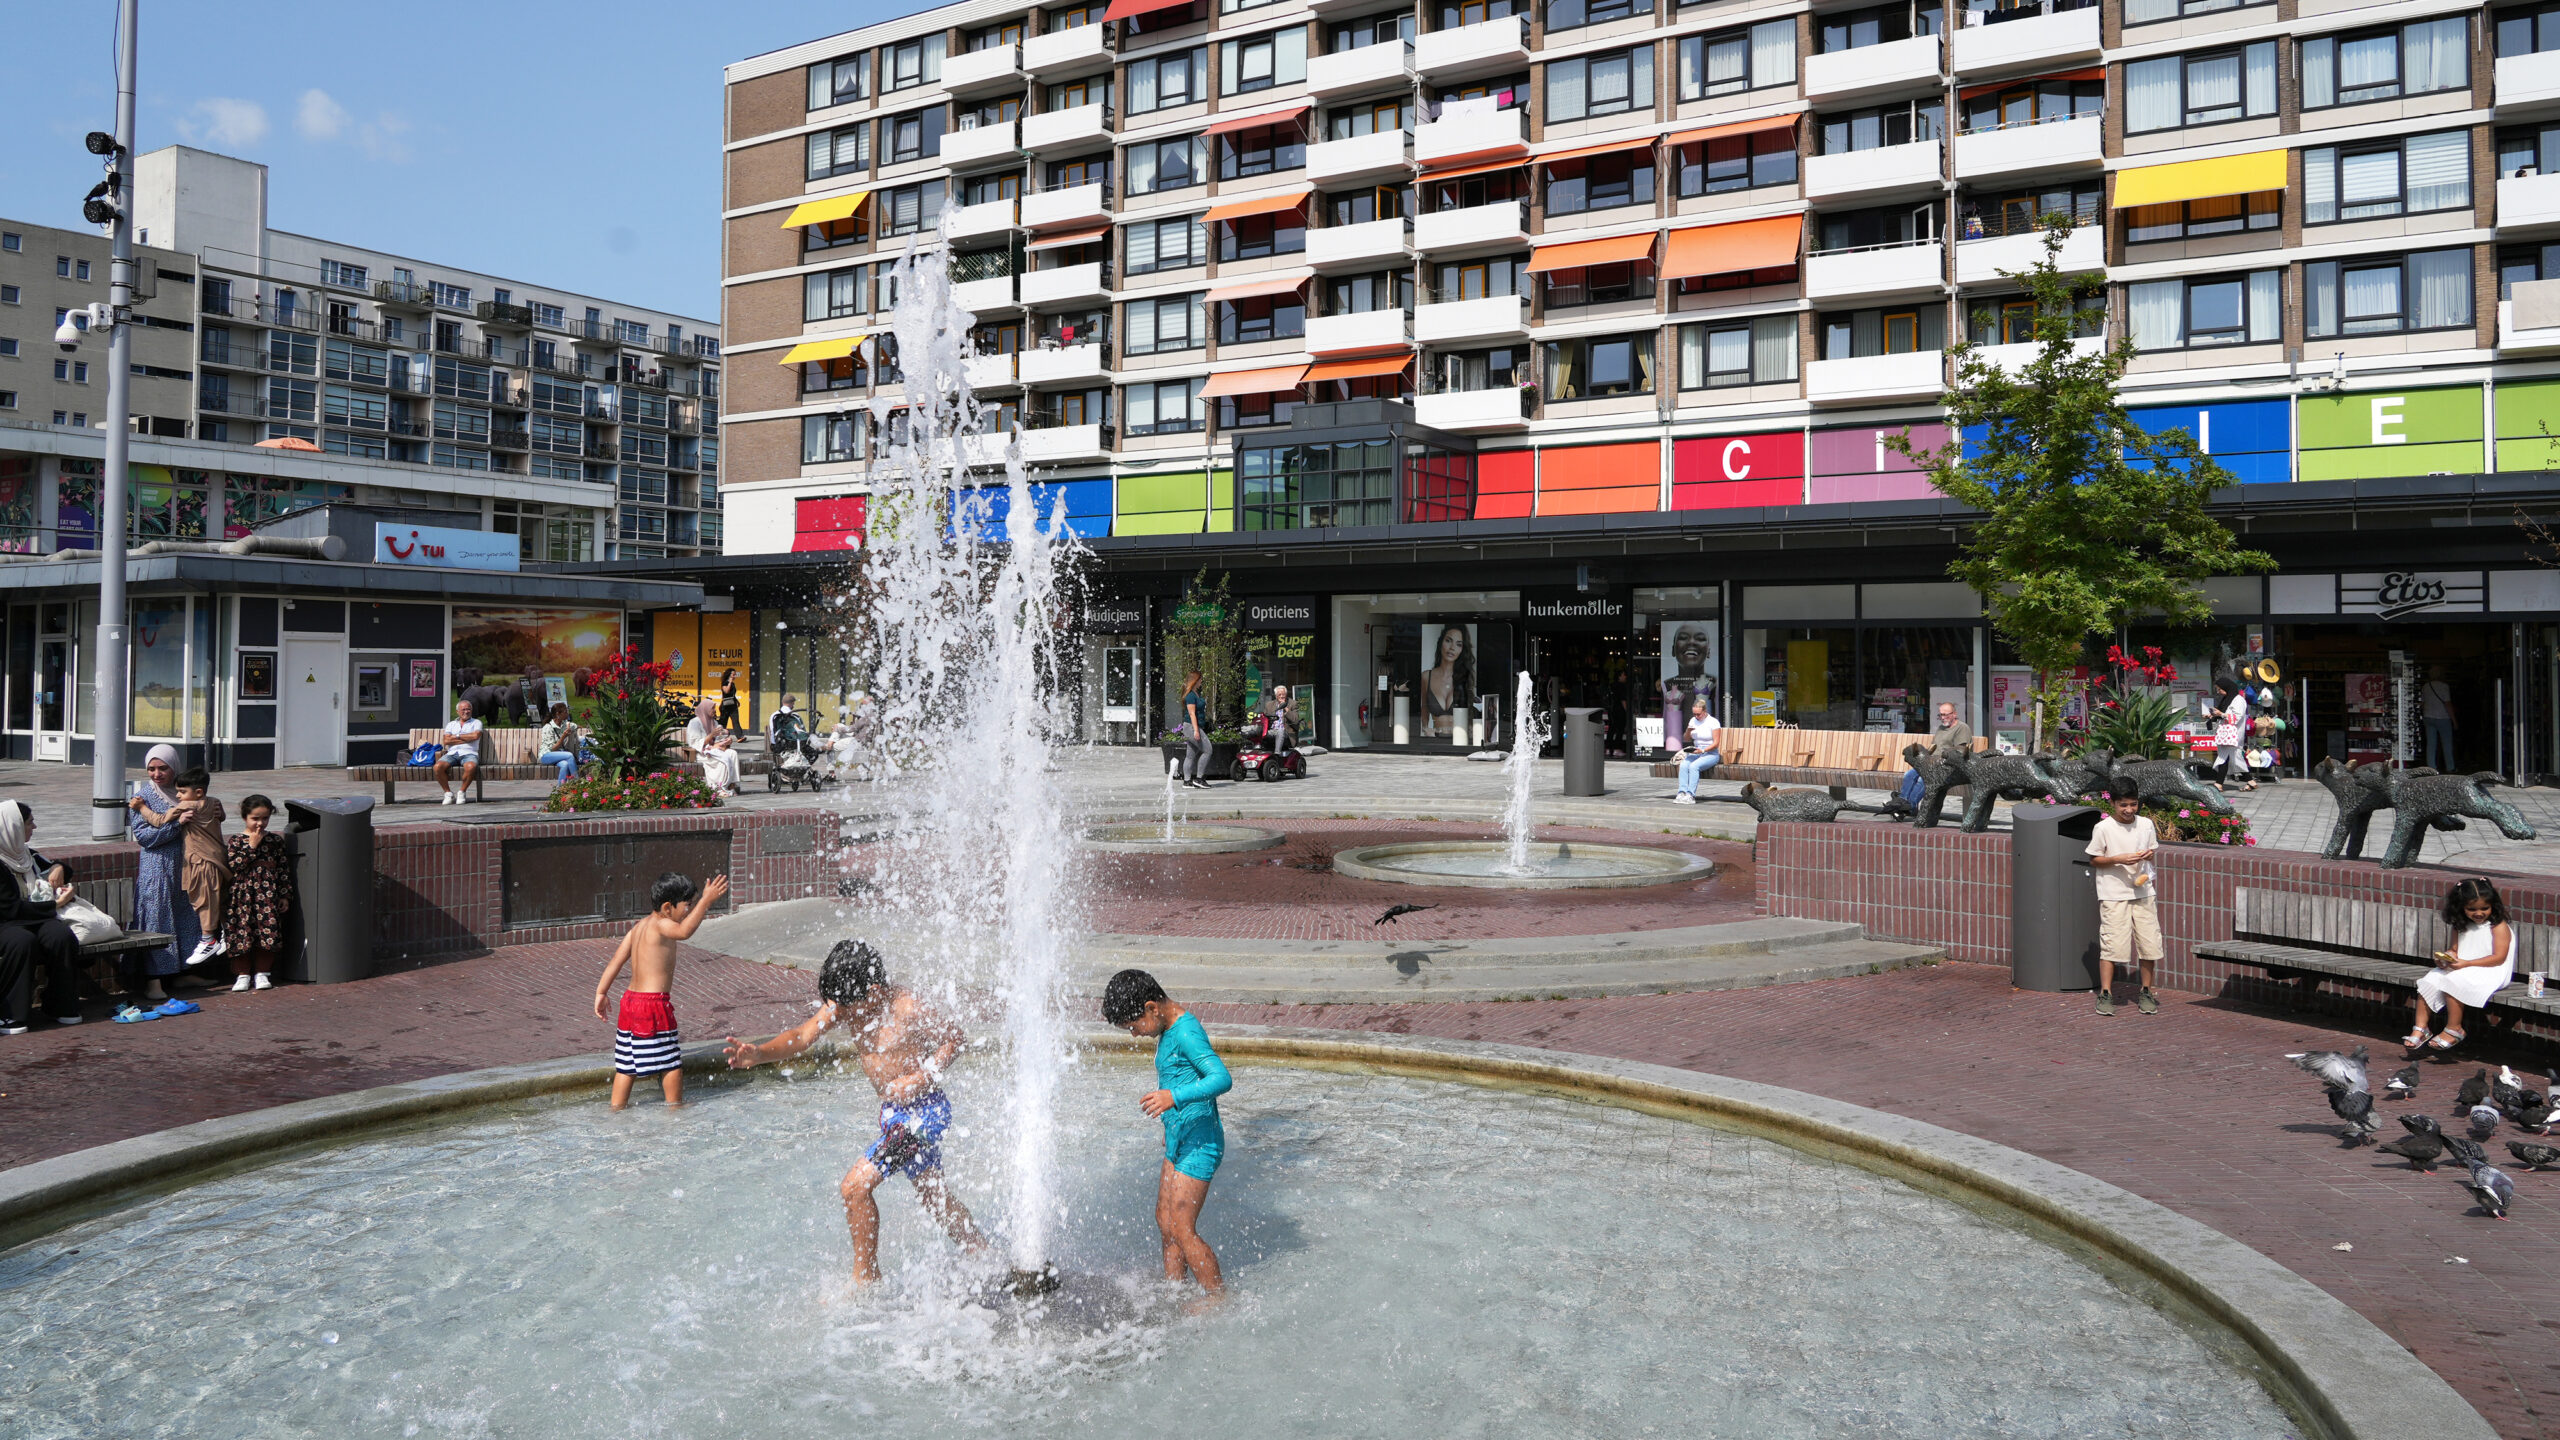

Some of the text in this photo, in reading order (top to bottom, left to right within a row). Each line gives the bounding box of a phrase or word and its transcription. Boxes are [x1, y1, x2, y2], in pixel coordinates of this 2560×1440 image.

[421, 544, 445, 558] TUI
[2377, 572, 2447, 607] Etos
[1086, 608, 1140, 622] Audiciens
[1251, 605, 1310, 622] Opticiens
[1527, 599, 1623, 617] hunkemöller
[1277, 634, 1314, 648] Super
[708, 648, 743, 659] TE HUUR
[1277, 645, 1305, 658] Deal
[1637, 725, 1664, 736] SALE
